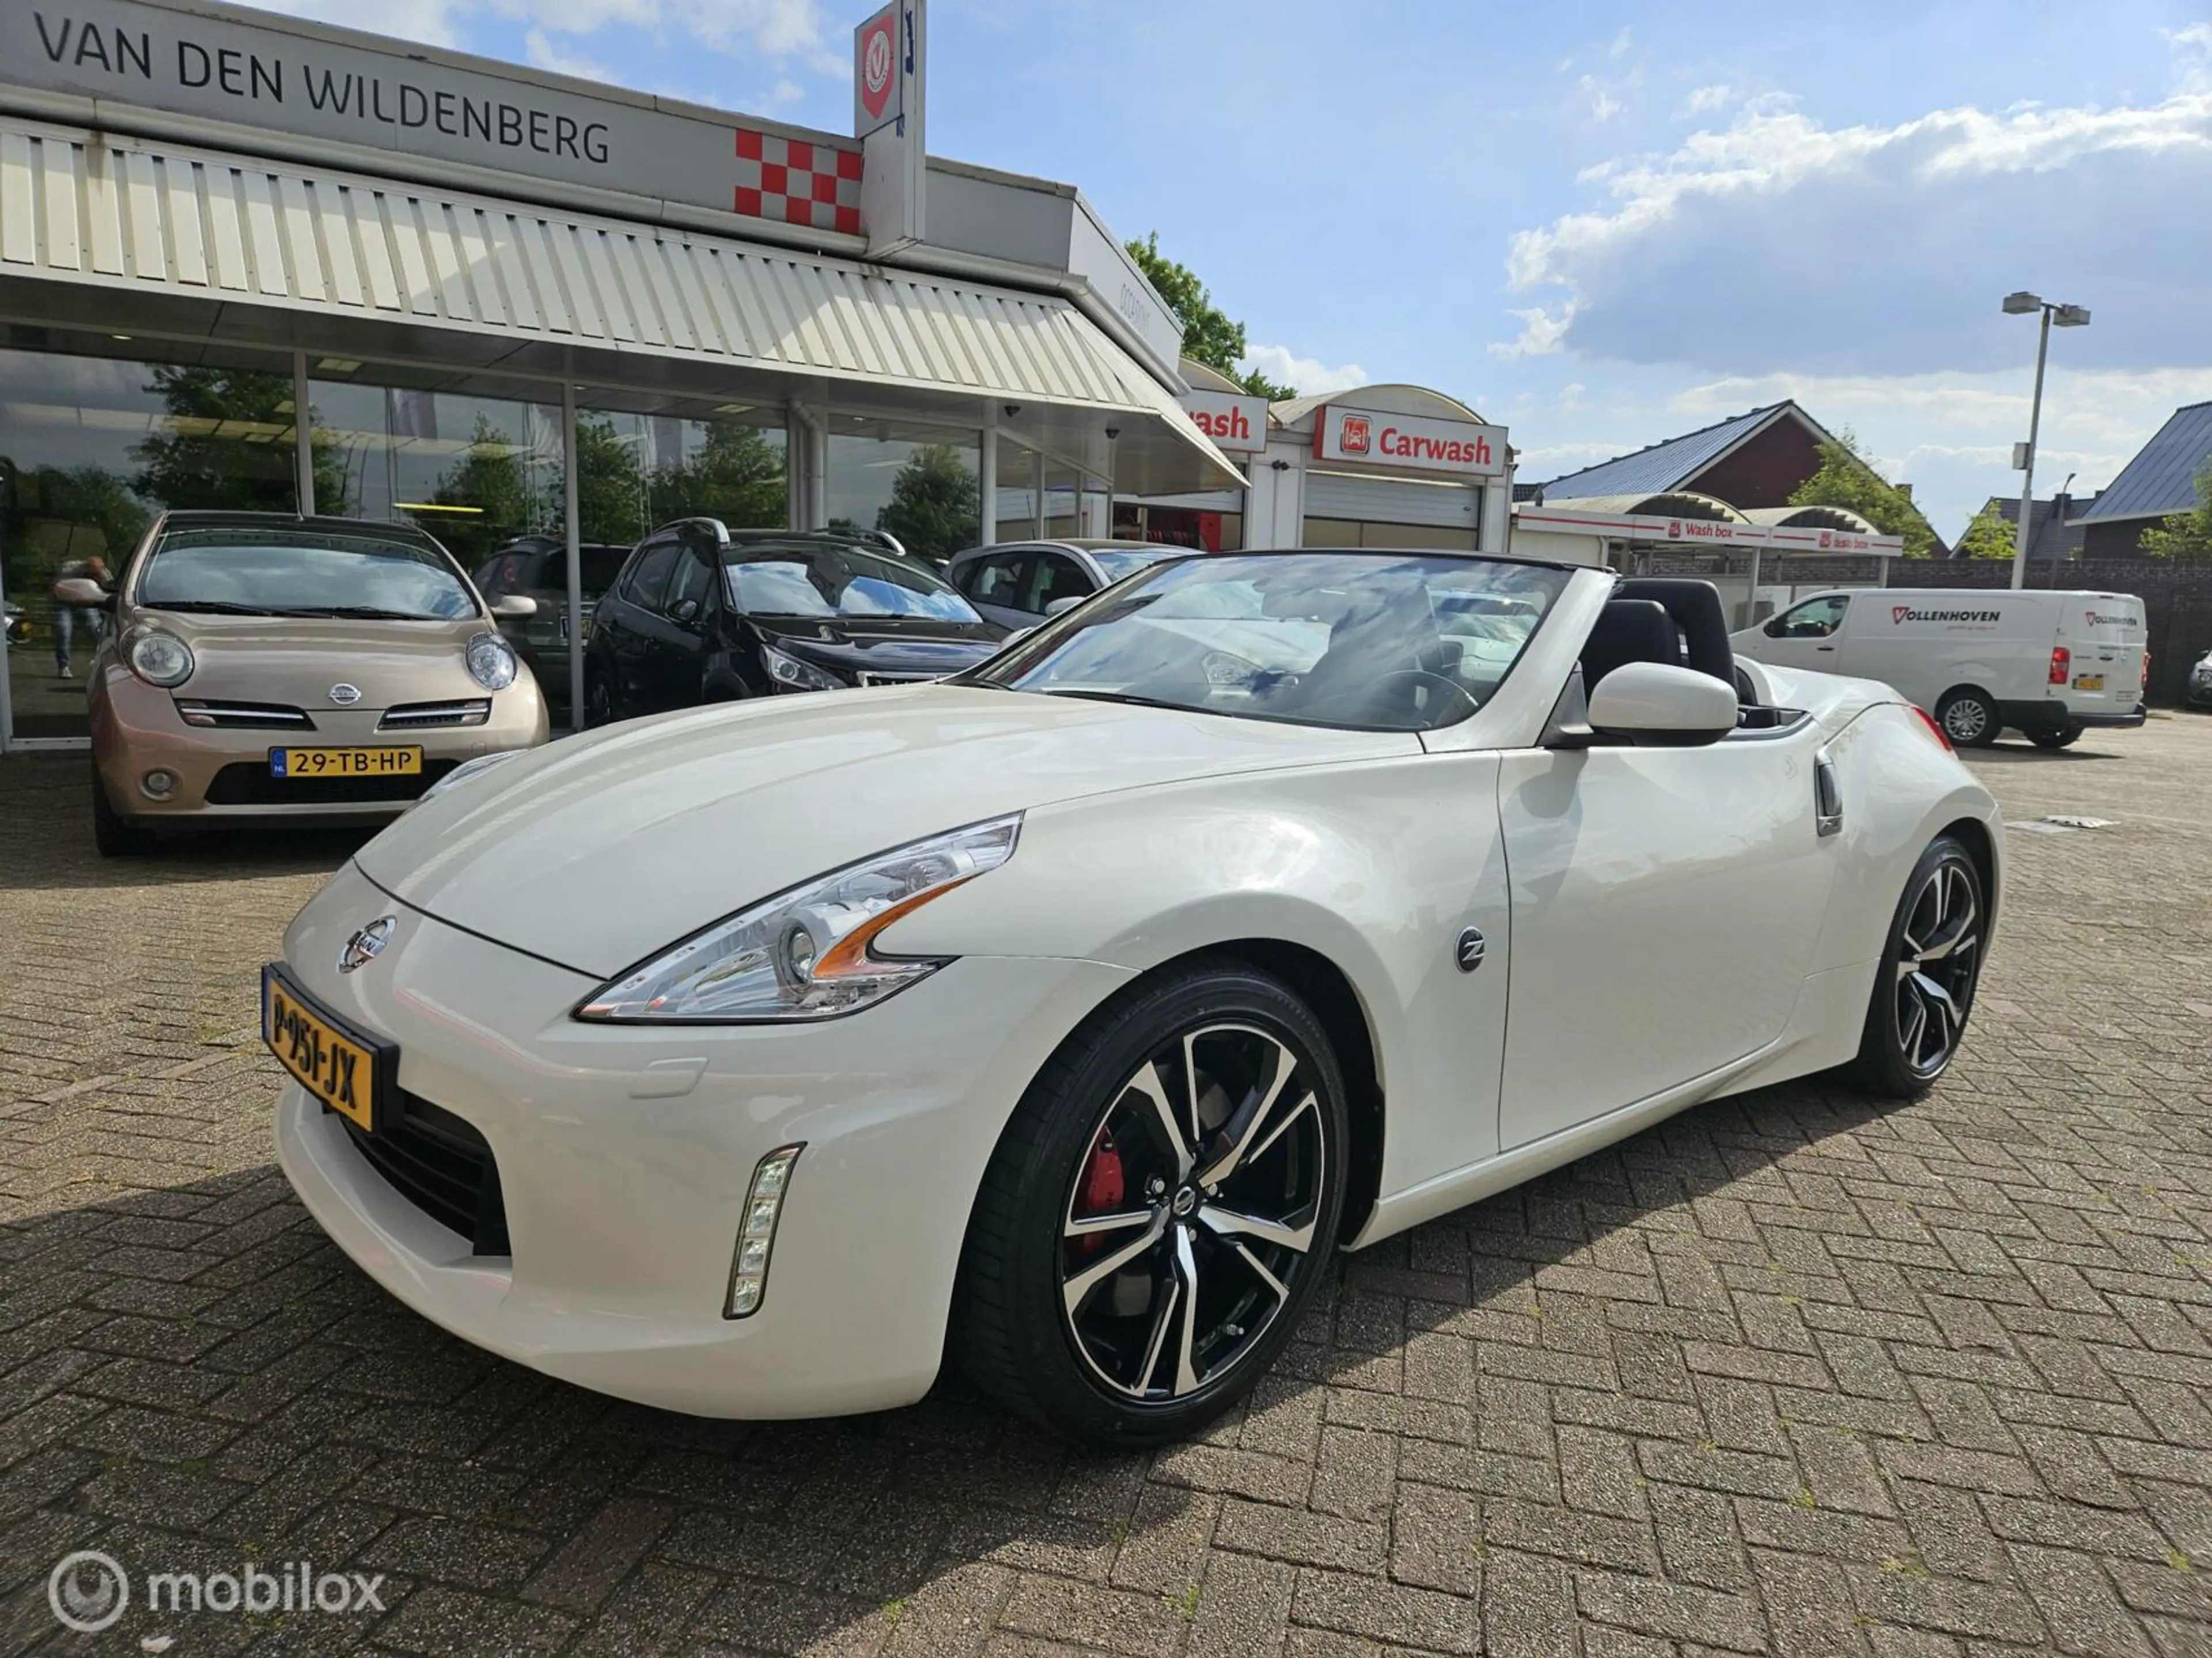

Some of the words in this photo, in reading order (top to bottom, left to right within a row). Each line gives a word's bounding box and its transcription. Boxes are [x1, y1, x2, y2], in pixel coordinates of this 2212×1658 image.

[33, 11, 151, 79] VAN
[178, 40, 283, 103] DEN
[303, 65, 608, 164] WILDENBERG
[1190, 405, 1249, 439] ash
[1380, 427, 1491, 465] Carwash
[1685, 523, 1713, 537] Wash
[1715, 523, 1732, 538] box
[1892, 606, 2001, 625] VOLLENHOVEN
[295, 752, 411, 772] 29-TB-HP
[274, 993, 357, 1109] P-951-JX
